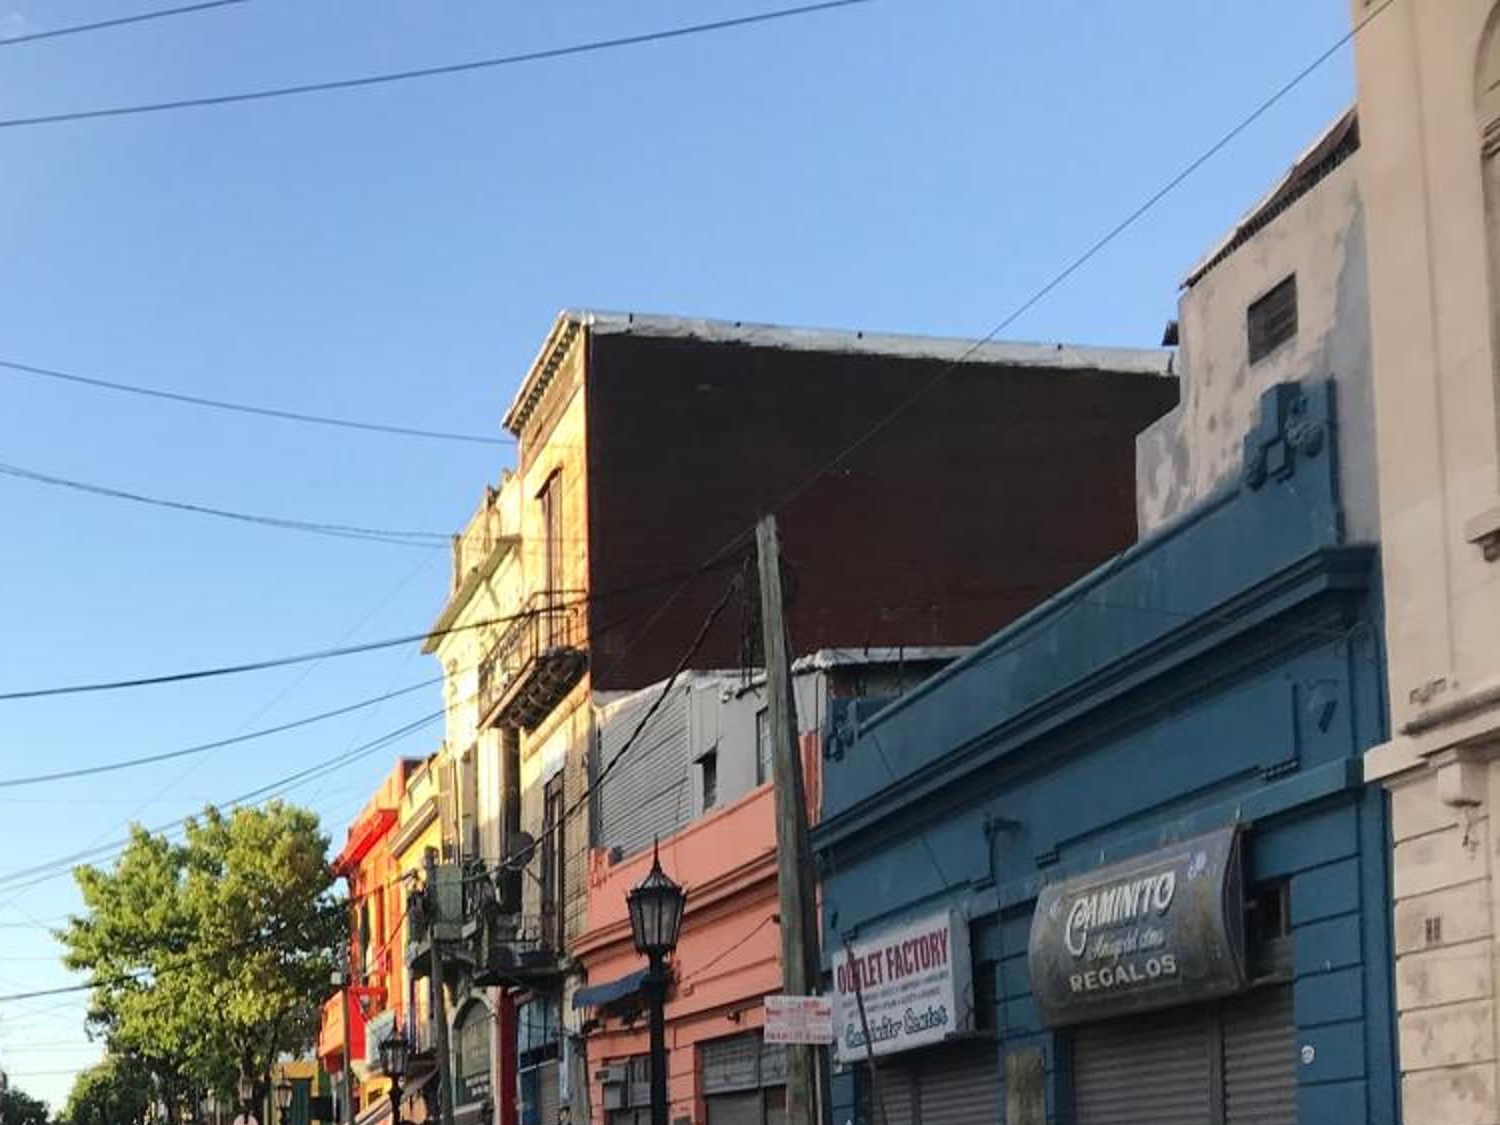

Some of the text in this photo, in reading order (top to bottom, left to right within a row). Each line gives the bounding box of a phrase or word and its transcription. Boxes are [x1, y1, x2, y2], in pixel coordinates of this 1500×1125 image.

[1064, 871, 1176, 956] CAMINITO
[886, 927, 948, 982] FACTORY
[1069, 954, 1177, 992] REGALOS
